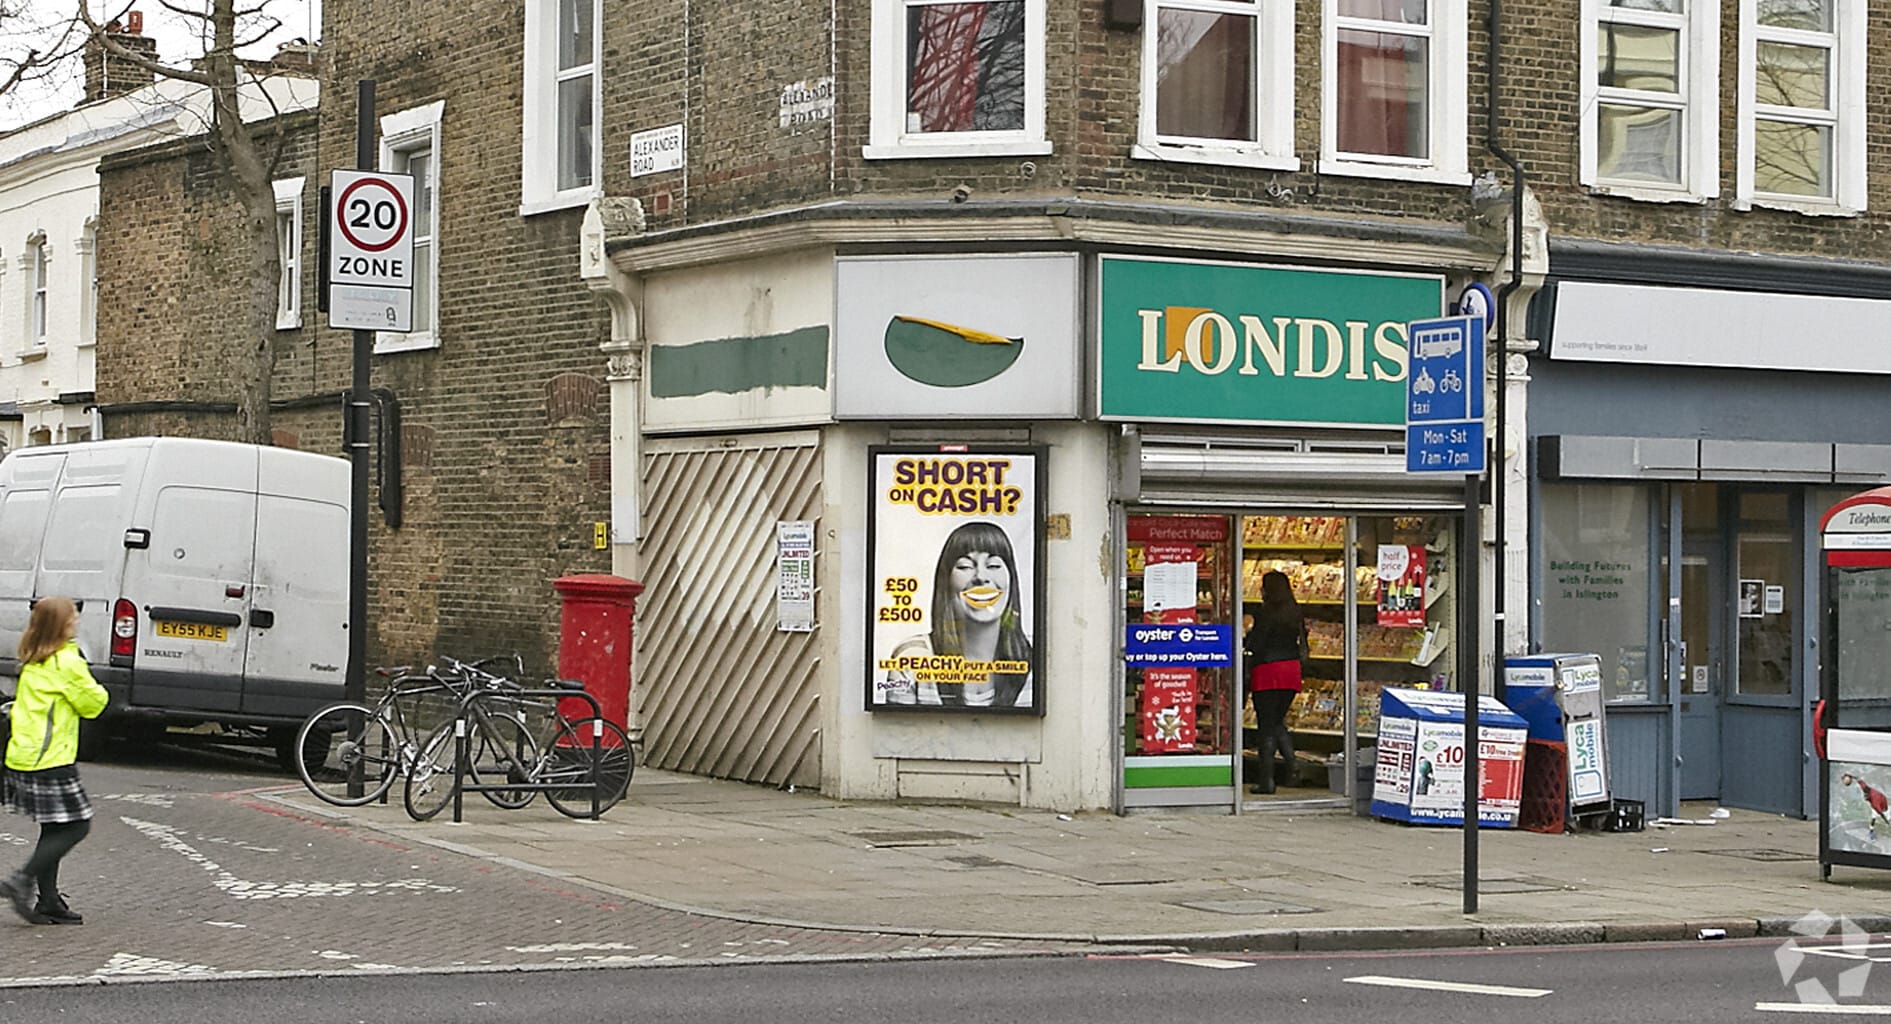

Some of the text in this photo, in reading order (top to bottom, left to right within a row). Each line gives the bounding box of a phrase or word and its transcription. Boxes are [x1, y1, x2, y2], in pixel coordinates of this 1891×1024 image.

[633, 135, 679, 156] ALEXANDER
[633, 156, 654, 174] ROAD
[350, 199, 396, 230] 20
[339, 257, 403, 277] ZONE
[1137, 308, 1409, 382] LONDIS
[1413, 400, 1430, 414] taxi
[896, 461, 1009, 485] SHORT
[890, 488, 1021, 512] ON CASH?
[1149, 527, 1222, 539] Perfect Match
[1383, 551, 1400, 561] half
[1382, 562, 1402, 571] price
[1550, 561, 1590, 572] Building
[885, 578, 918, 592] £50
[1559, 575, 1623, 584] with Families
[893, 595, 912, 606] TO
[1563, 589, 1618, 600] in Islington
[879, 608, 922, 622] £500
[162, 622, 223, 638] EY55 KJE
[1135, 628, 1175, 643] oyster
[144, 649, 183, 658] RENAULT
[1145, 653, 1157, 662] top
[1159, 654, 1168, 662] up
[1169, 654, 1185, 662] your
[1186, 652, 1209, 662] Oyster
[879, 660, 897, 668] LET
[964, 662, 985, 670] PUT
[995, 662, 1026, 671] SMILE
[916, 672, 987, 681] ON YOUR FACE
[1511, 672, 1545, 681] Lycamobile
[1575, 669, 1598, 681] Lyca
[1423, 728, 1463, 738] Lycamobile
[1379, 740, 1413, 751] UNLIMITED
[1575, 724, 1588, 769] Lyca
[1585, 723, 1596, 768] mobile
[1436, 745, 1464, 764] £10
